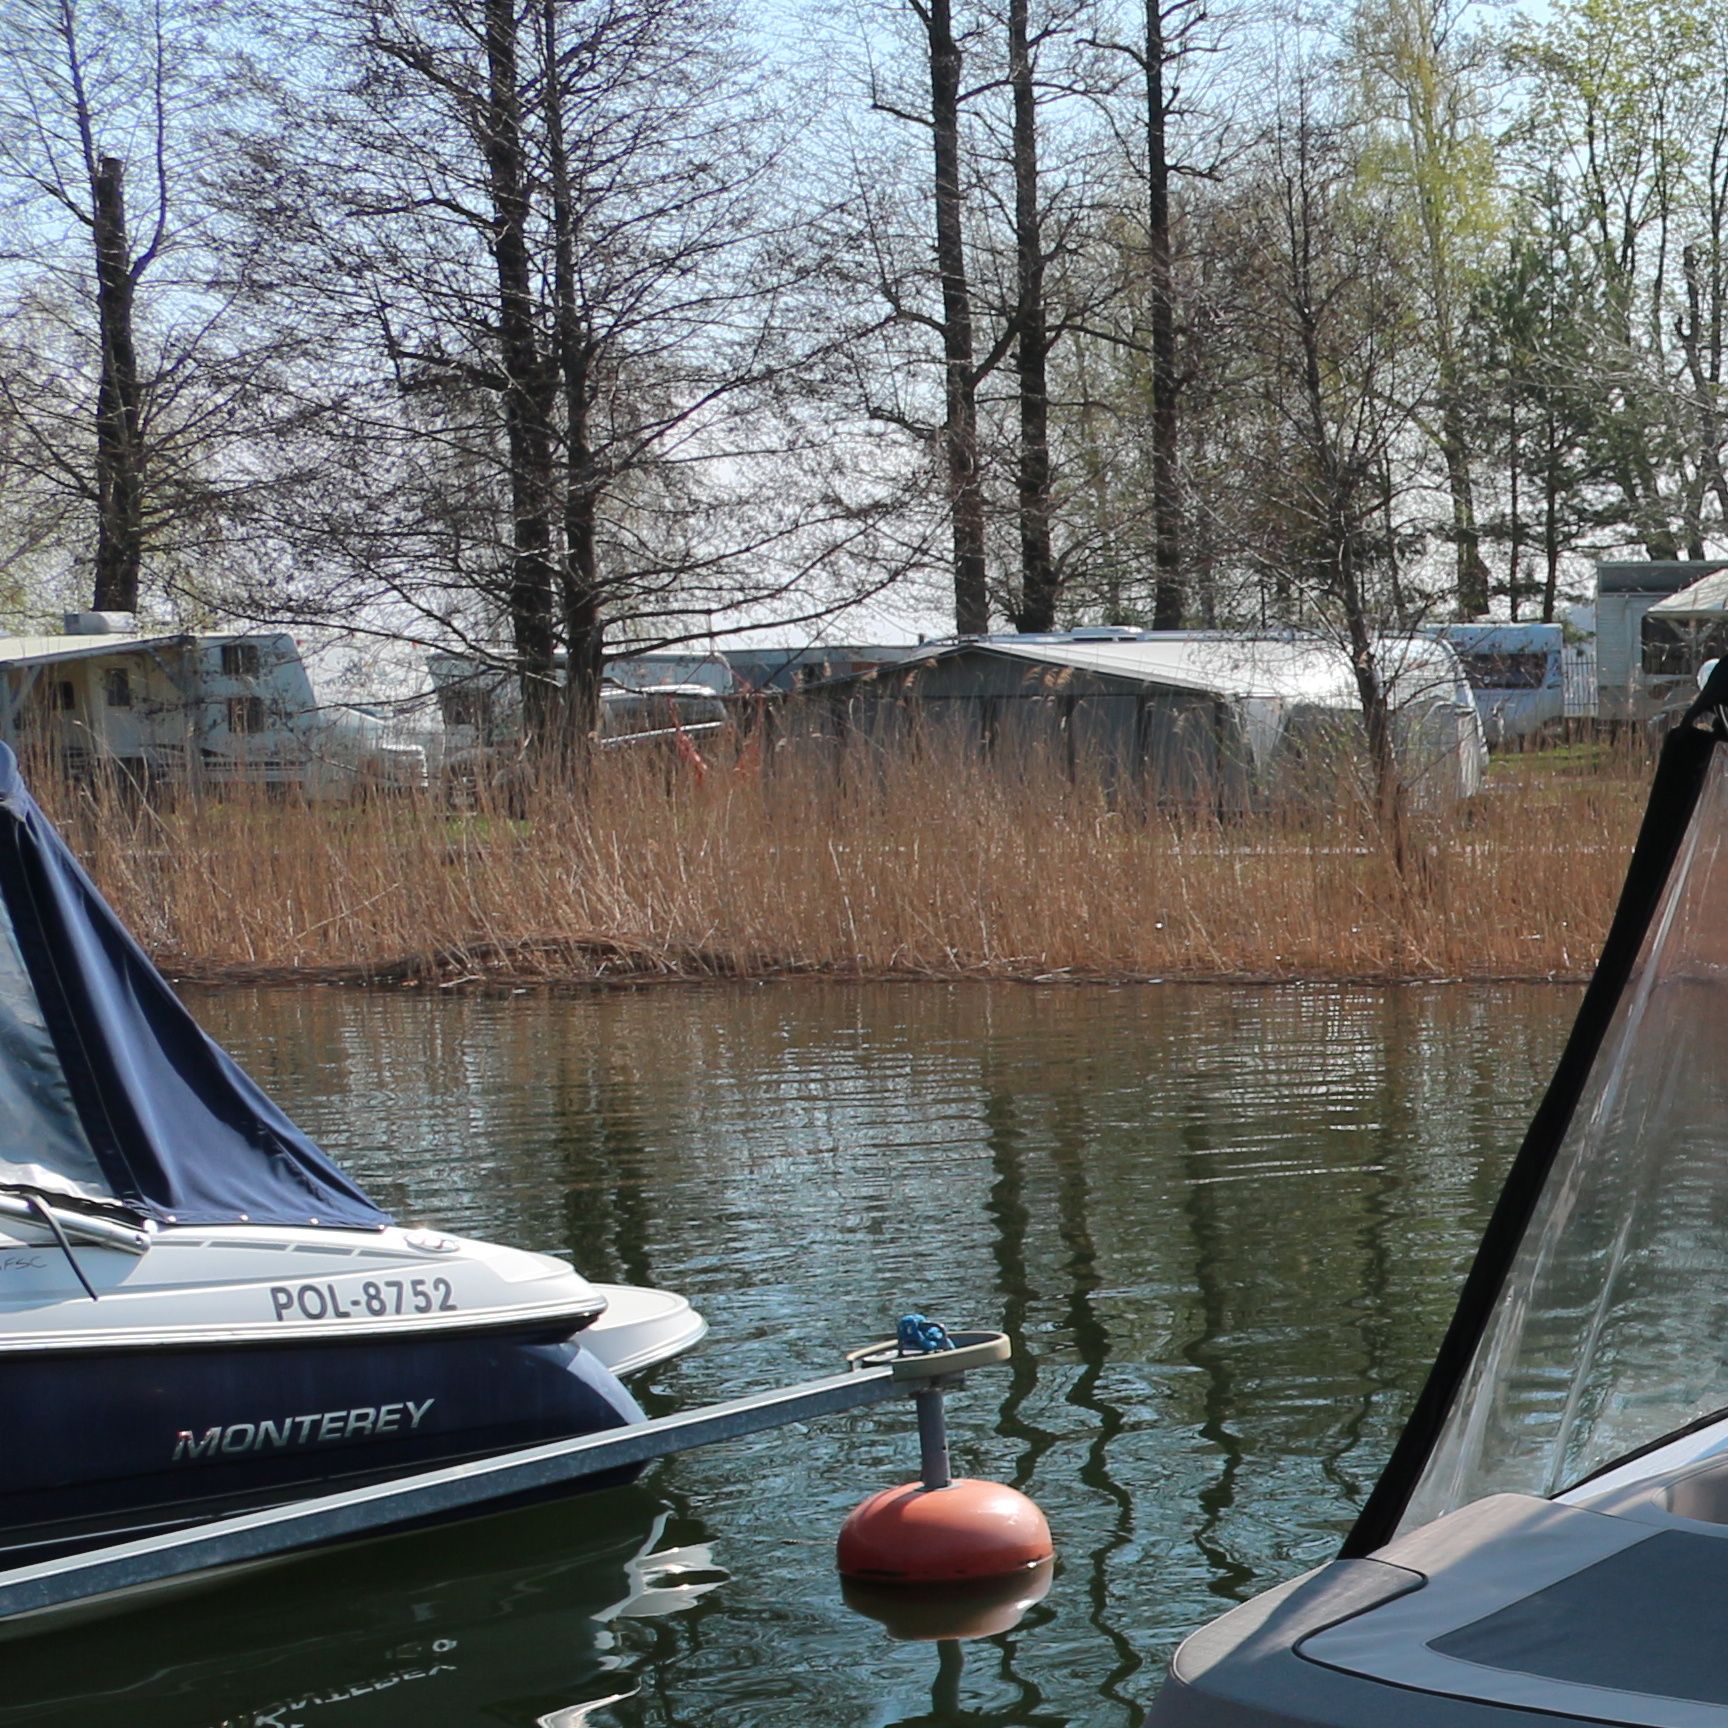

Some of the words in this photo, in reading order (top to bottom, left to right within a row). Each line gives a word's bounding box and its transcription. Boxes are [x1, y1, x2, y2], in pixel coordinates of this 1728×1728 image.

[0, 1255, 47, 1271] FSC
[270, 1277, 458, 1321] POL-8752
[172, 1398, 435, 1461] MONTEREY
